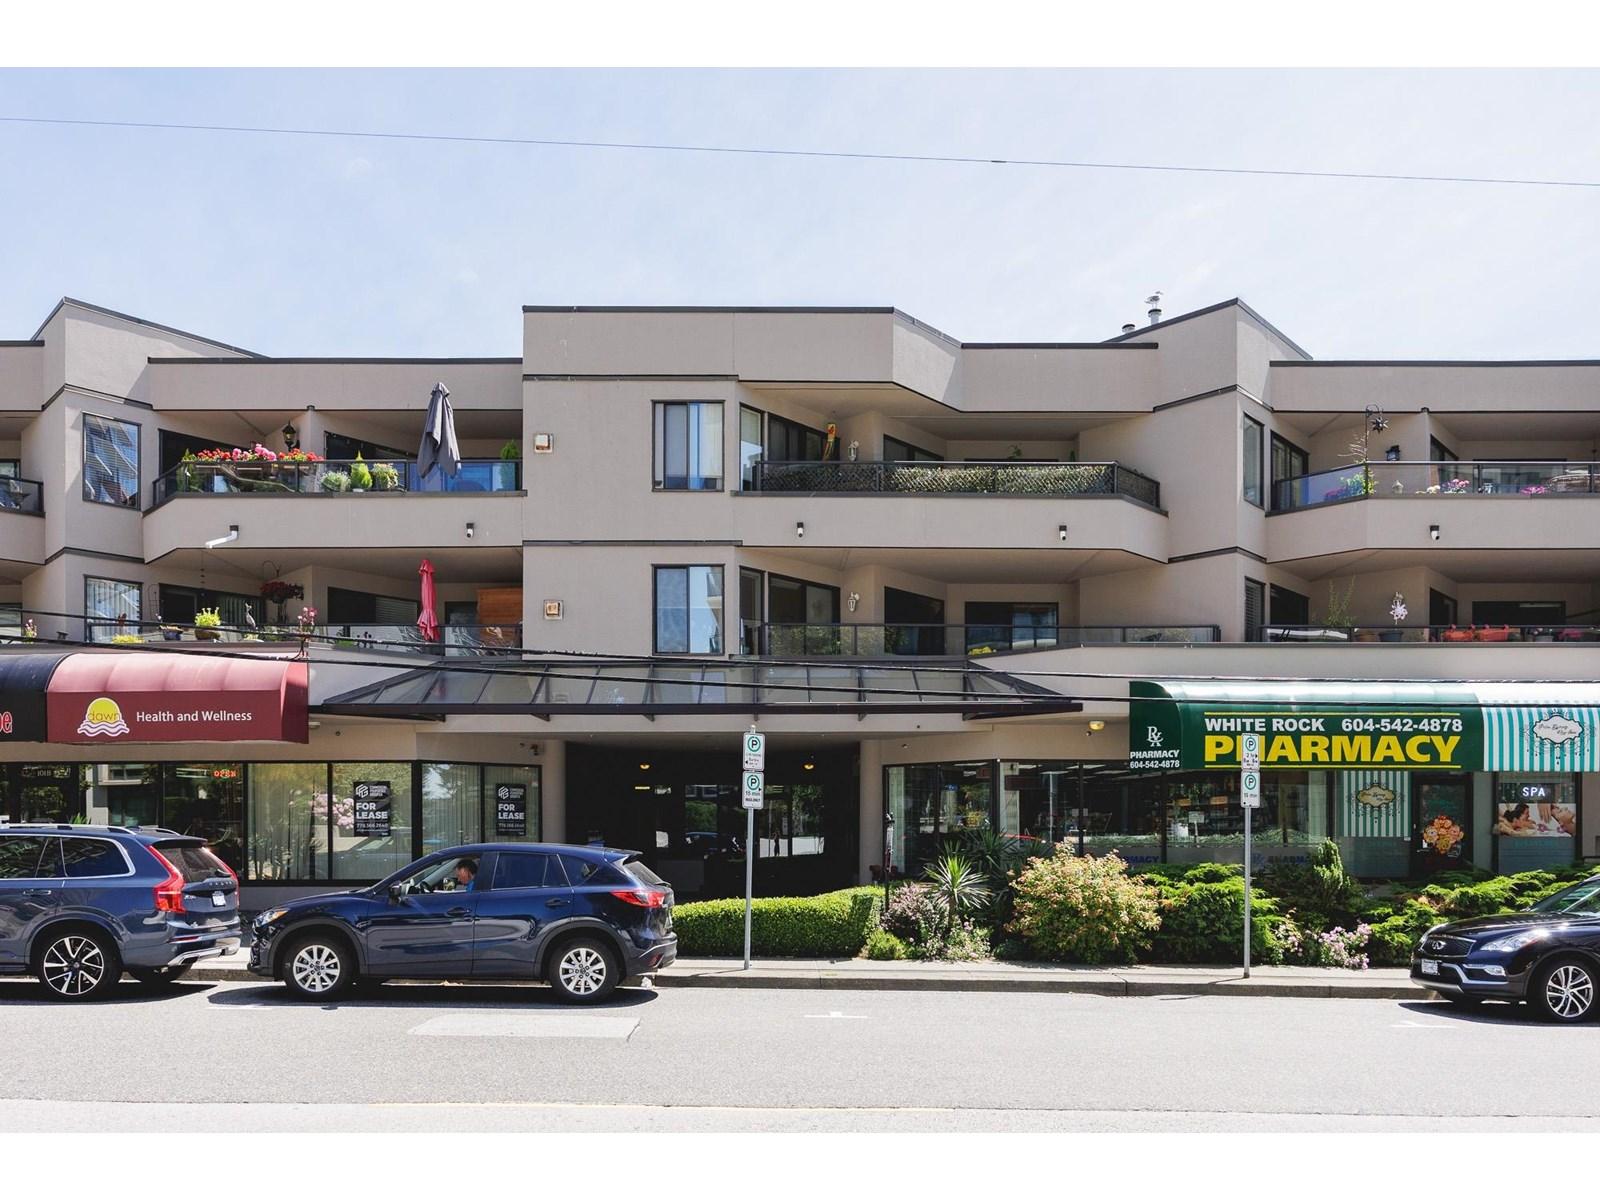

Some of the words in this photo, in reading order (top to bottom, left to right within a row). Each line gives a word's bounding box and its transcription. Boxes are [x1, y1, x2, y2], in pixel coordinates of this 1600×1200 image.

[136, 711, 174, 722] Health
[177, 710, 199, 722] and
[201, 710, 252, 721] Wellness
[1204, 718, 1266, 732] WHITE
[1272, 718, 1326, 732] ROCK
[1341, 718, 1463, 732] 604-542-4878
[1129, 750, 1180, 759] PHARMACY
[1129, 760, 1180, 769] 604-542-4878
[1522, 786, 1546, 797] SPA
[356, 802, 377, 811] FOR
[498, 803, 516, 811] FOR
[356, 811, 389, 820] LEASE
[498, 812, 525, 820] LEASE
